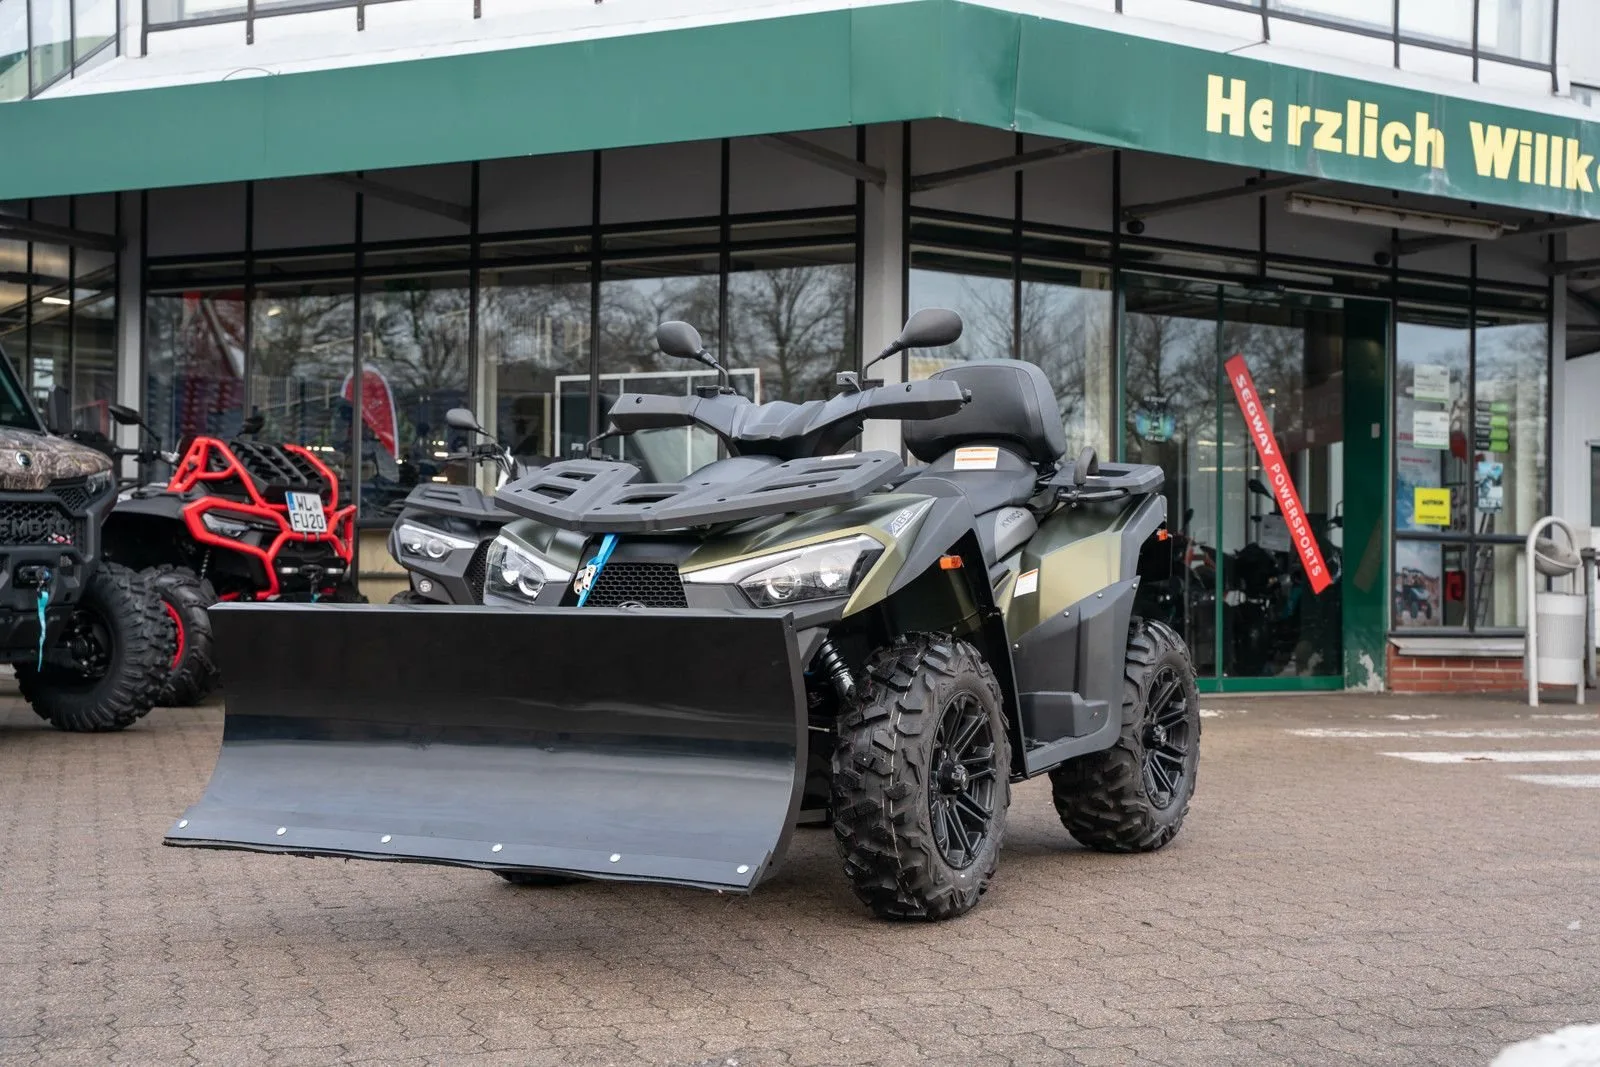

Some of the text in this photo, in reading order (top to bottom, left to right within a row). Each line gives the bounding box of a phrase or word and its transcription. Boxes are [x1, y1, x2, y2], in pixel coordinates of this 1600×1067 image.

[1469, 121, 1600, 193] Willk
[1236, 373, 1322, 577] SEGWAY POWERSPORTS
[295, 495, 312, 511] WL
[292, 512, 324, 529] FU20
[890, 509, 914, 536] ABS
